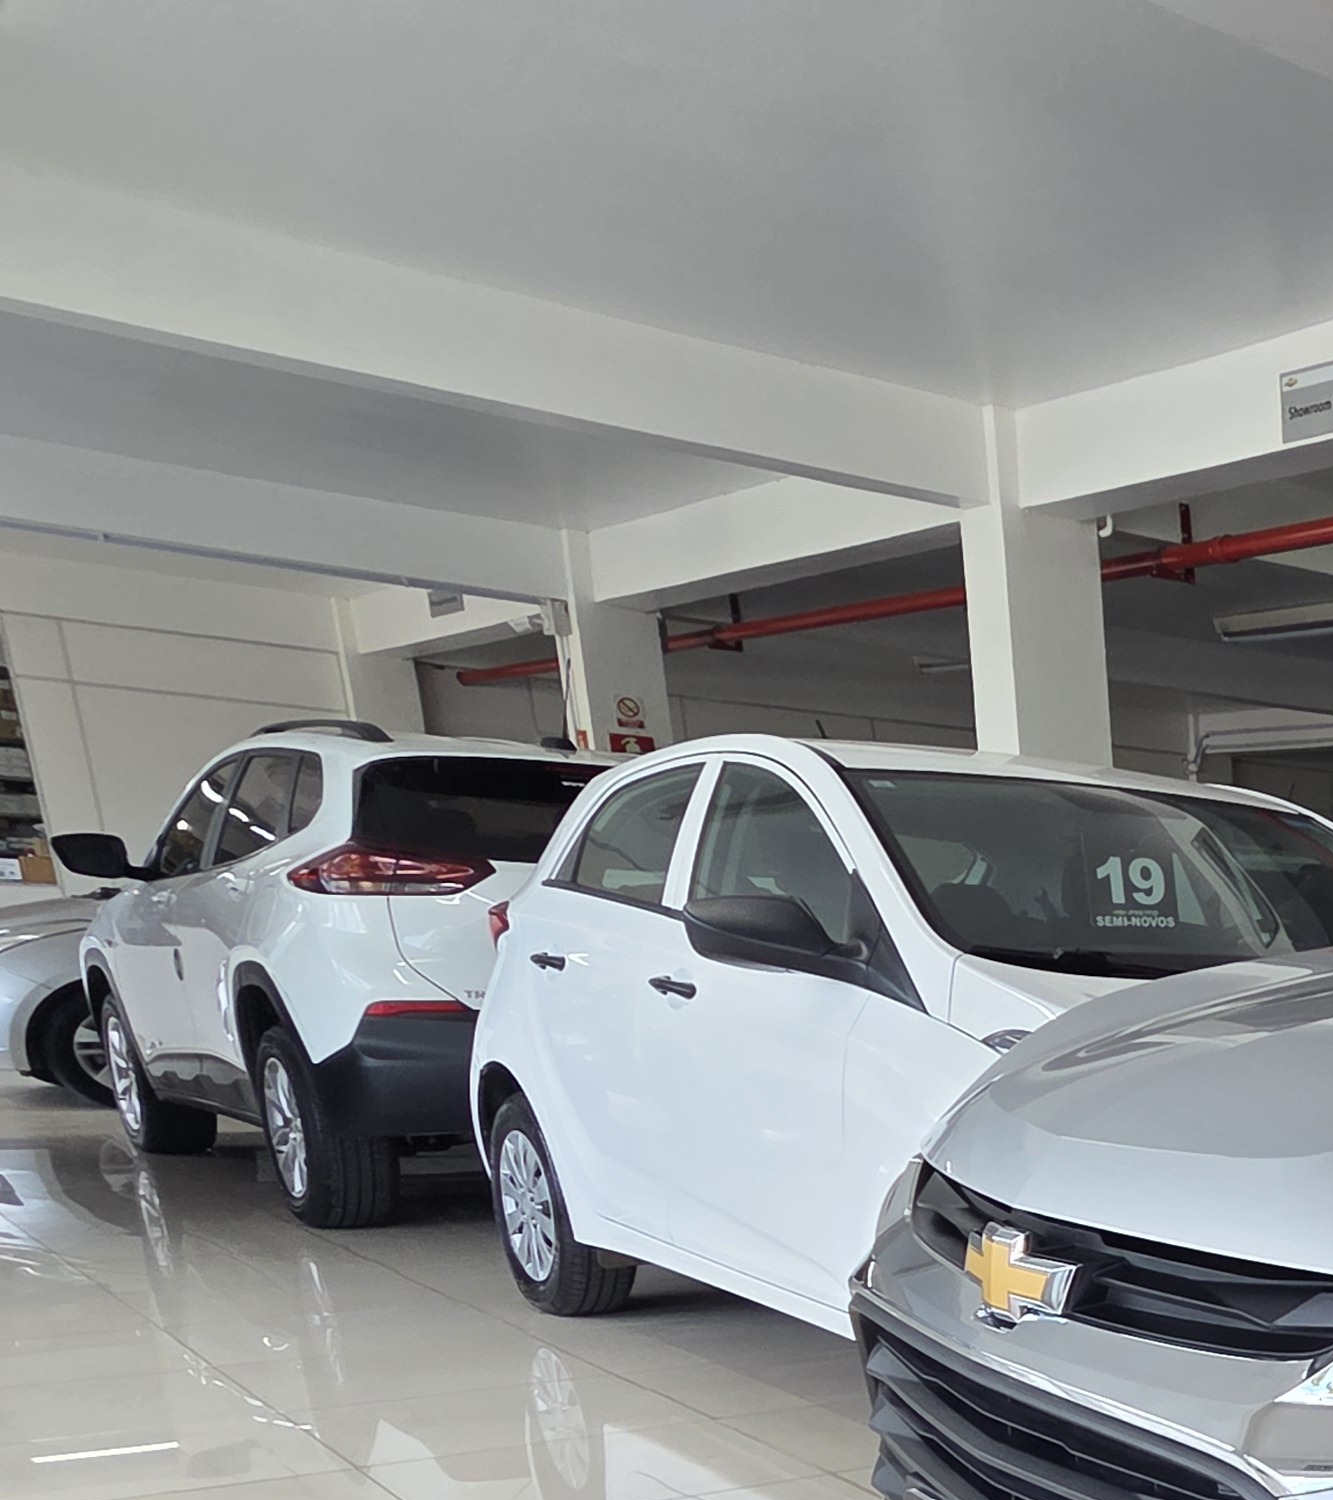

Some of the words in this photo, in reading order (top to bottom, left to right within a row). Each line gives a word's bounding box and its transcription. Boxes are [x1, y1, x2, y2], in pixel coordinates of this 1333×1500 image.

[1288, 400, 1332, 420] Showroom
[1096, 856, 1165, 905] 19
[1096, 915, 1175, 928] SEMI-NOVOS
